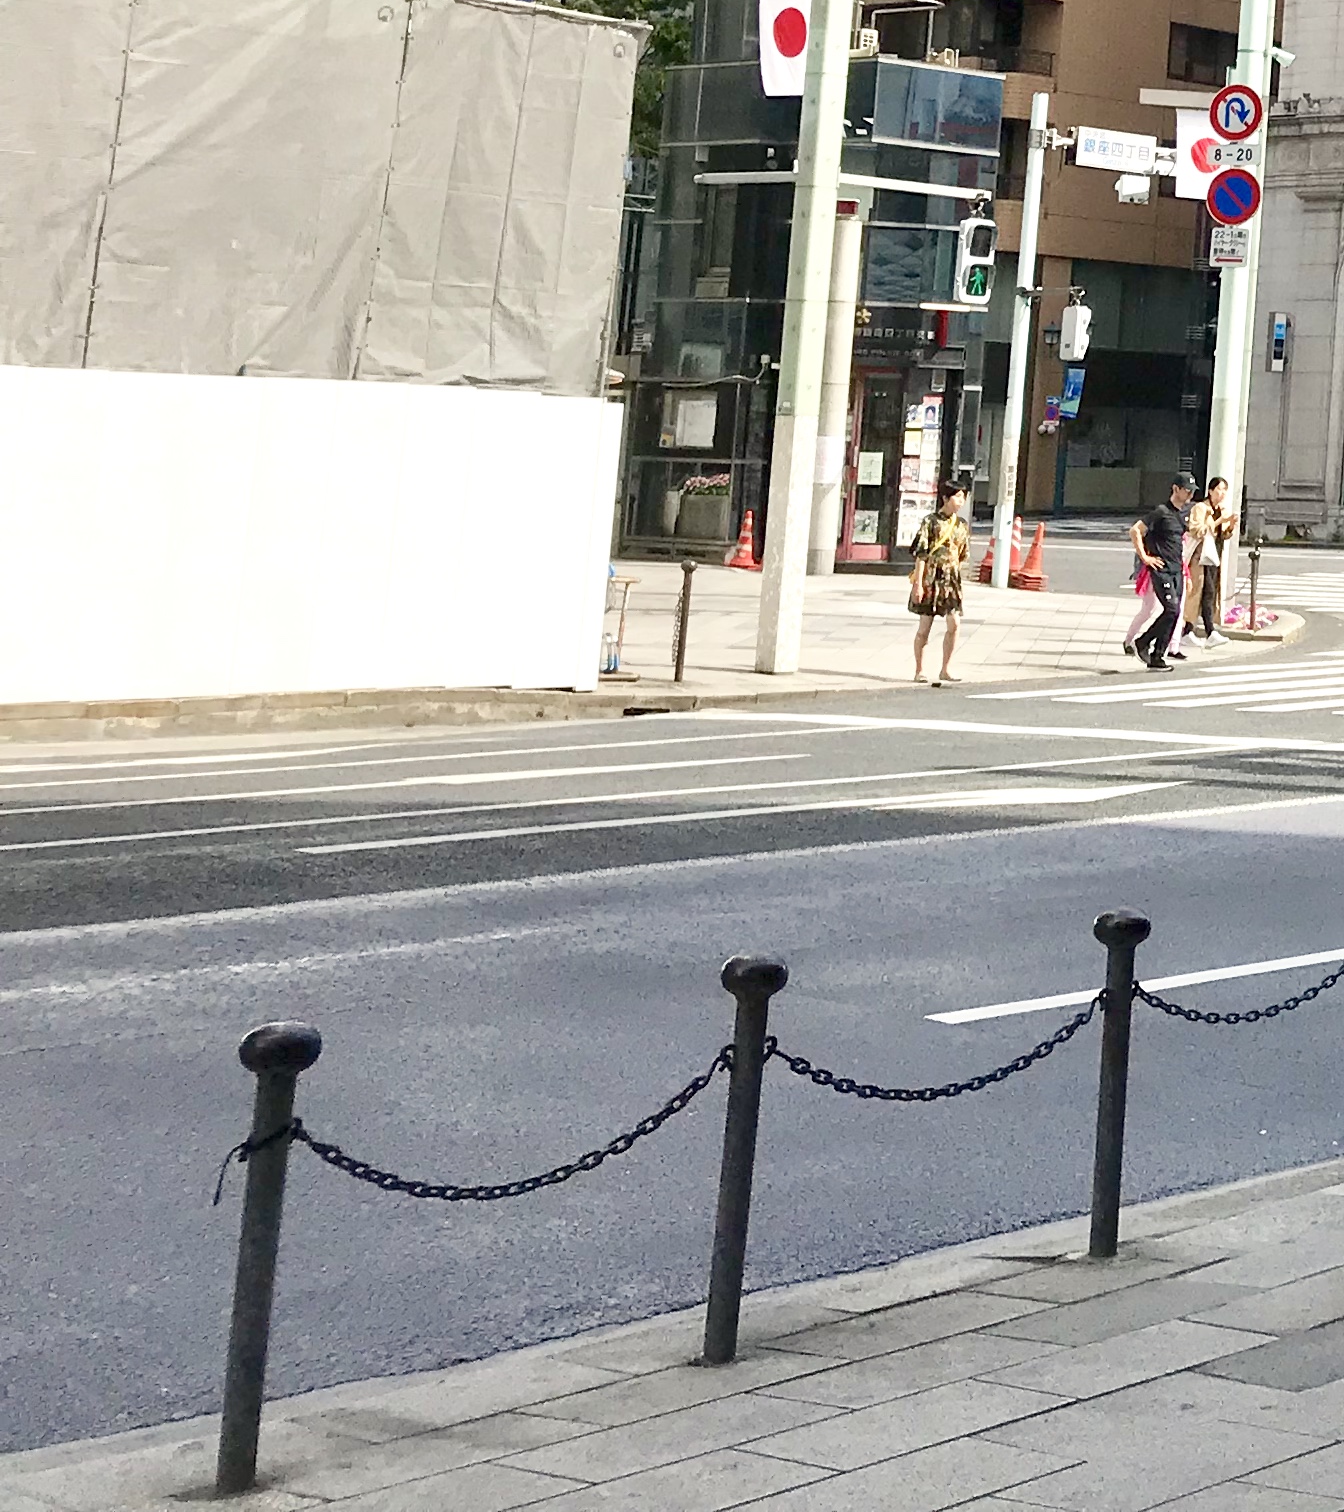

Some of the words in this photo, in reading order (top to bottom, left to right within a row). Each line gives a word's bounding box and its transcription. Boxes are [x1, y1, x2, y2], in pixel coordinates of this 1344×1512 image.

[1083, 138, 1150, 161] 銀座四丁目
